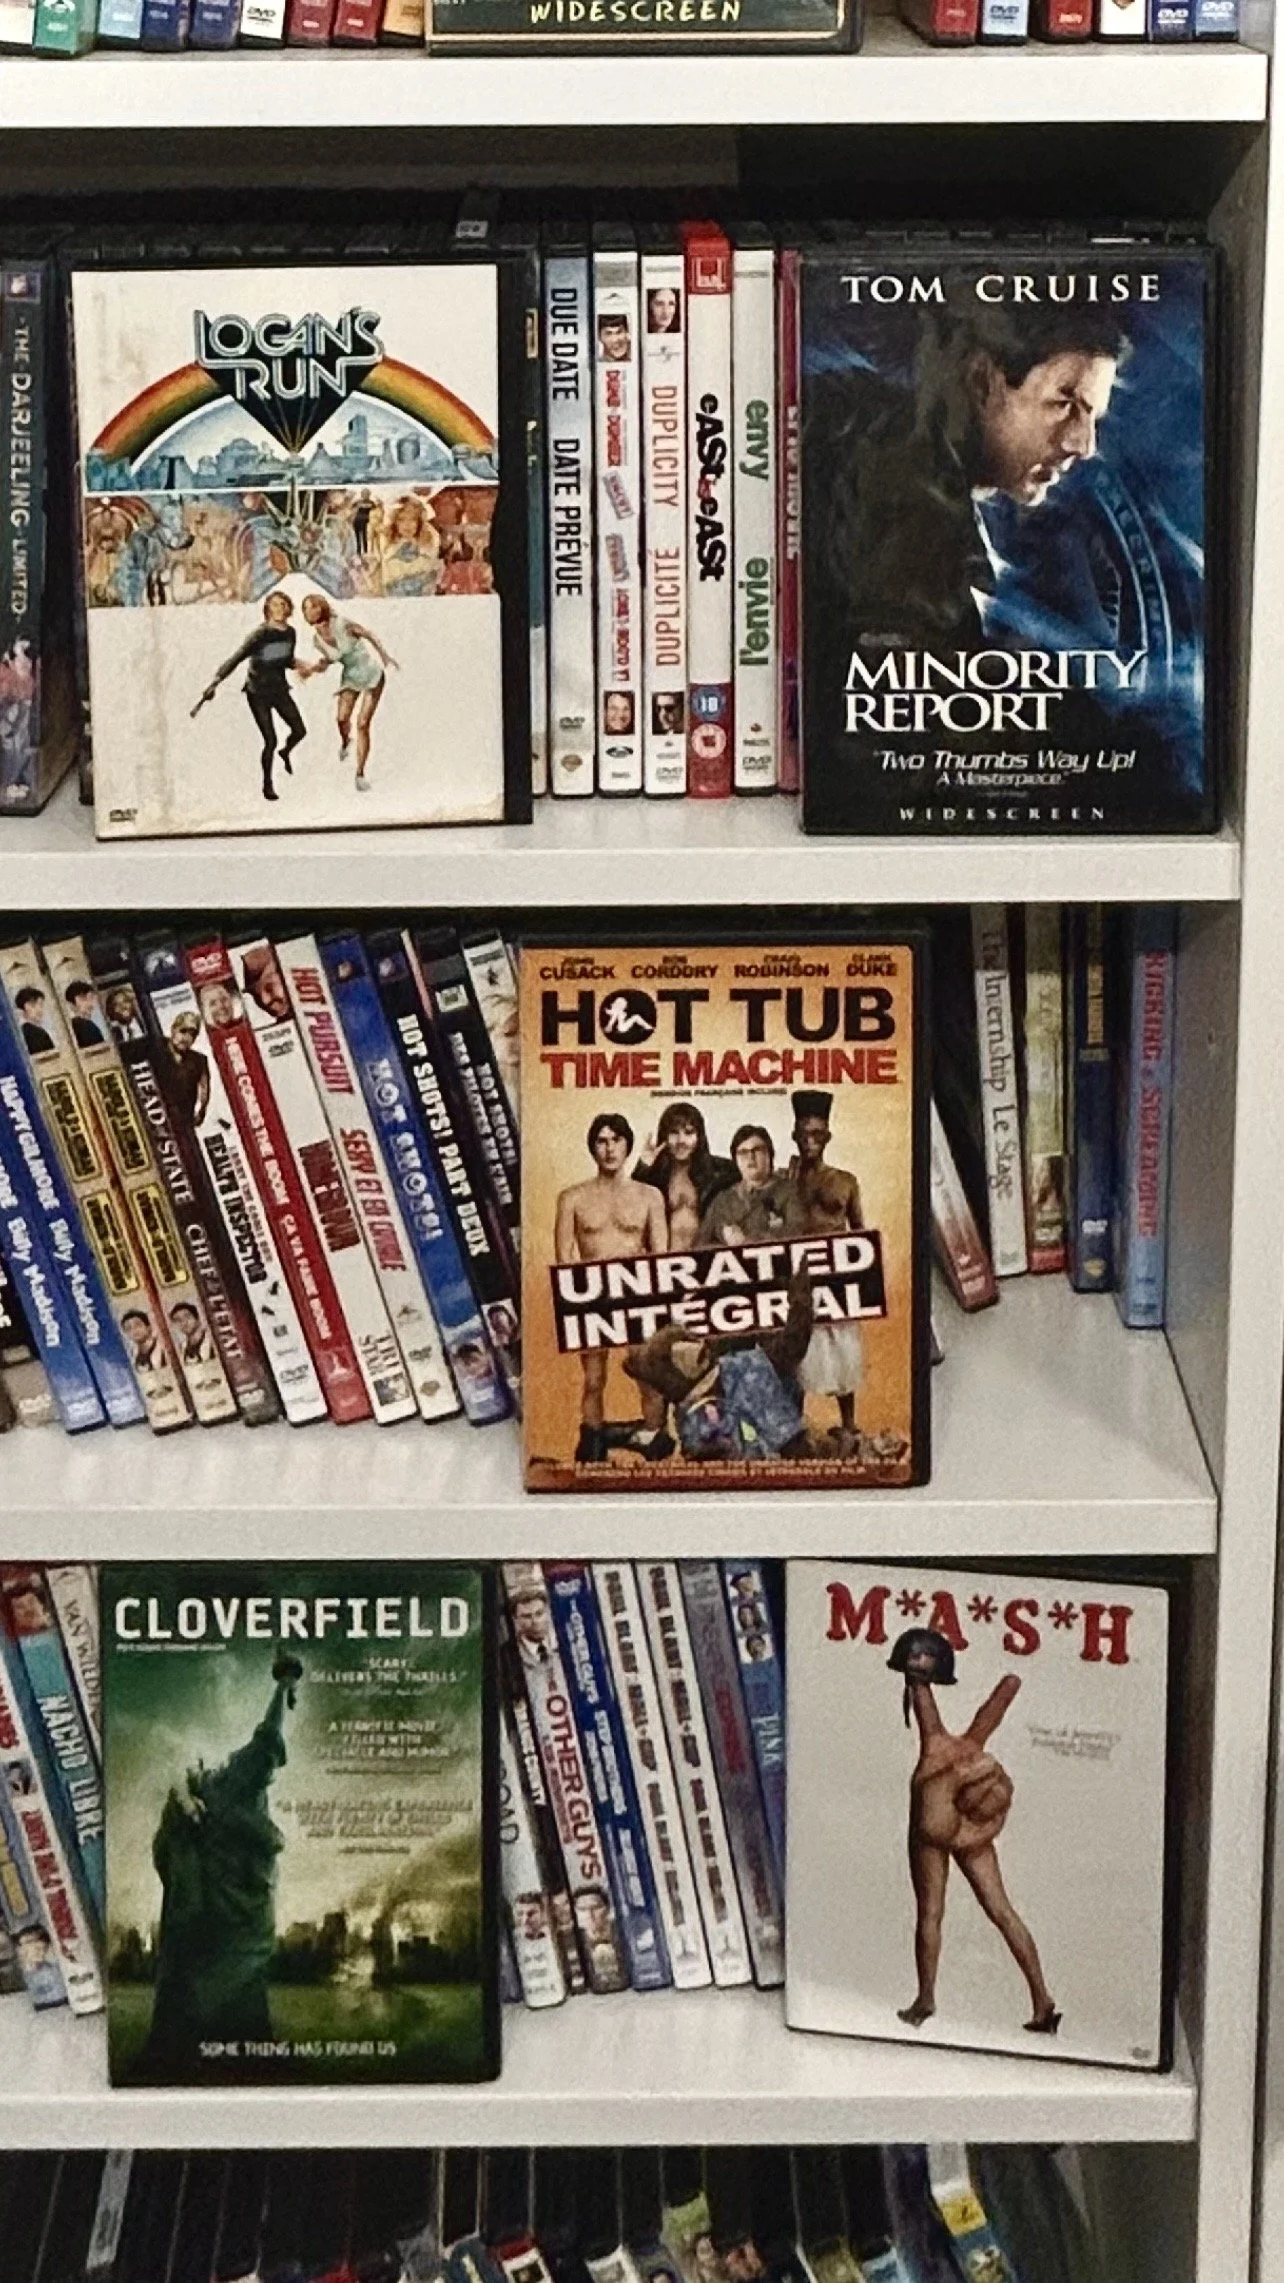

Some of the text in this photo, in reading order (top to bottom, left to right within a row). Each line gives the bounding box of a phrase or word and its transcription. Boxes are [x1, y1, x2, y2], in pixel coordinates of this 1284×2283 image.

[531, 0, 741, 22] WIDESCREEN
[841, 273, 1160, 303] TOM CRUISE
[194, 307, 385, 362] LOGAN'S
[550, 288, 580, 401] DUE DATE
[234, 356, 358, 402] RUN
[11, 372, 34, 526] DARJEELING
[651, 385, 679, 507] DUPLICITY
[738, 399, 770, 480] envy
[553, 438, 588, 597] DATE PRÉVUE
[14, 533, 31, 614] LIMITED
[738, 556, 769, 666] l'envie
[844, 650, 1149, 691] MINORITY
[845, 691, 1064, 733] REPORT
[934, 749, 1030, 770] Thumbs
[1038, 750, 1090, 772] Way
[1096, 749, 1137, 772] Up!
[936, 771, 951, 785] A
[900, 806, 1105, 821] WIDESCREEN
[290, 966, 327, 1008] HOT
[539, 964, 616, 981] CUSACK
[846, 961, 898, 977] DUKE
[540, 985, 897, 1046] HOT TUB
[982, 973, 1015, 1092] Internship
[305, 1007, 355, 1095] PURSUIT
[540, 1047, 900, 1089] TIME MACHINE
[131, 1059, 168, 1127] HEAD
[157, 1138, 195, 1204] STATE
[363, 1056, 448, 1242] HOT SHOTS!
[395, 1012, 490, 1257] HOT SHOTS! PART DEUX
[992, 1104, 1016, 1132] Le
[18, 1129, 60, 1210] GILMORE
[988, 1138, 1015, 1199] Stage
[203, 1131, 268, 1285] HEALTH INSPECTOR
[185, 1222, 217, 1282] CHEF
[556, 1236, 876, 1303] UNRATED
[563, 1281, 882, 1350] INTÉGRAL
[115, 1597, 469, 1639] CLOVERFIELD
[37, 1695, 89, 1769] NACHO
[69, 1777, 105, 1847] LIBRE
[547, 1695, 585, 1795] OTHER
[567, 1800, 600, 1880] GUYS
